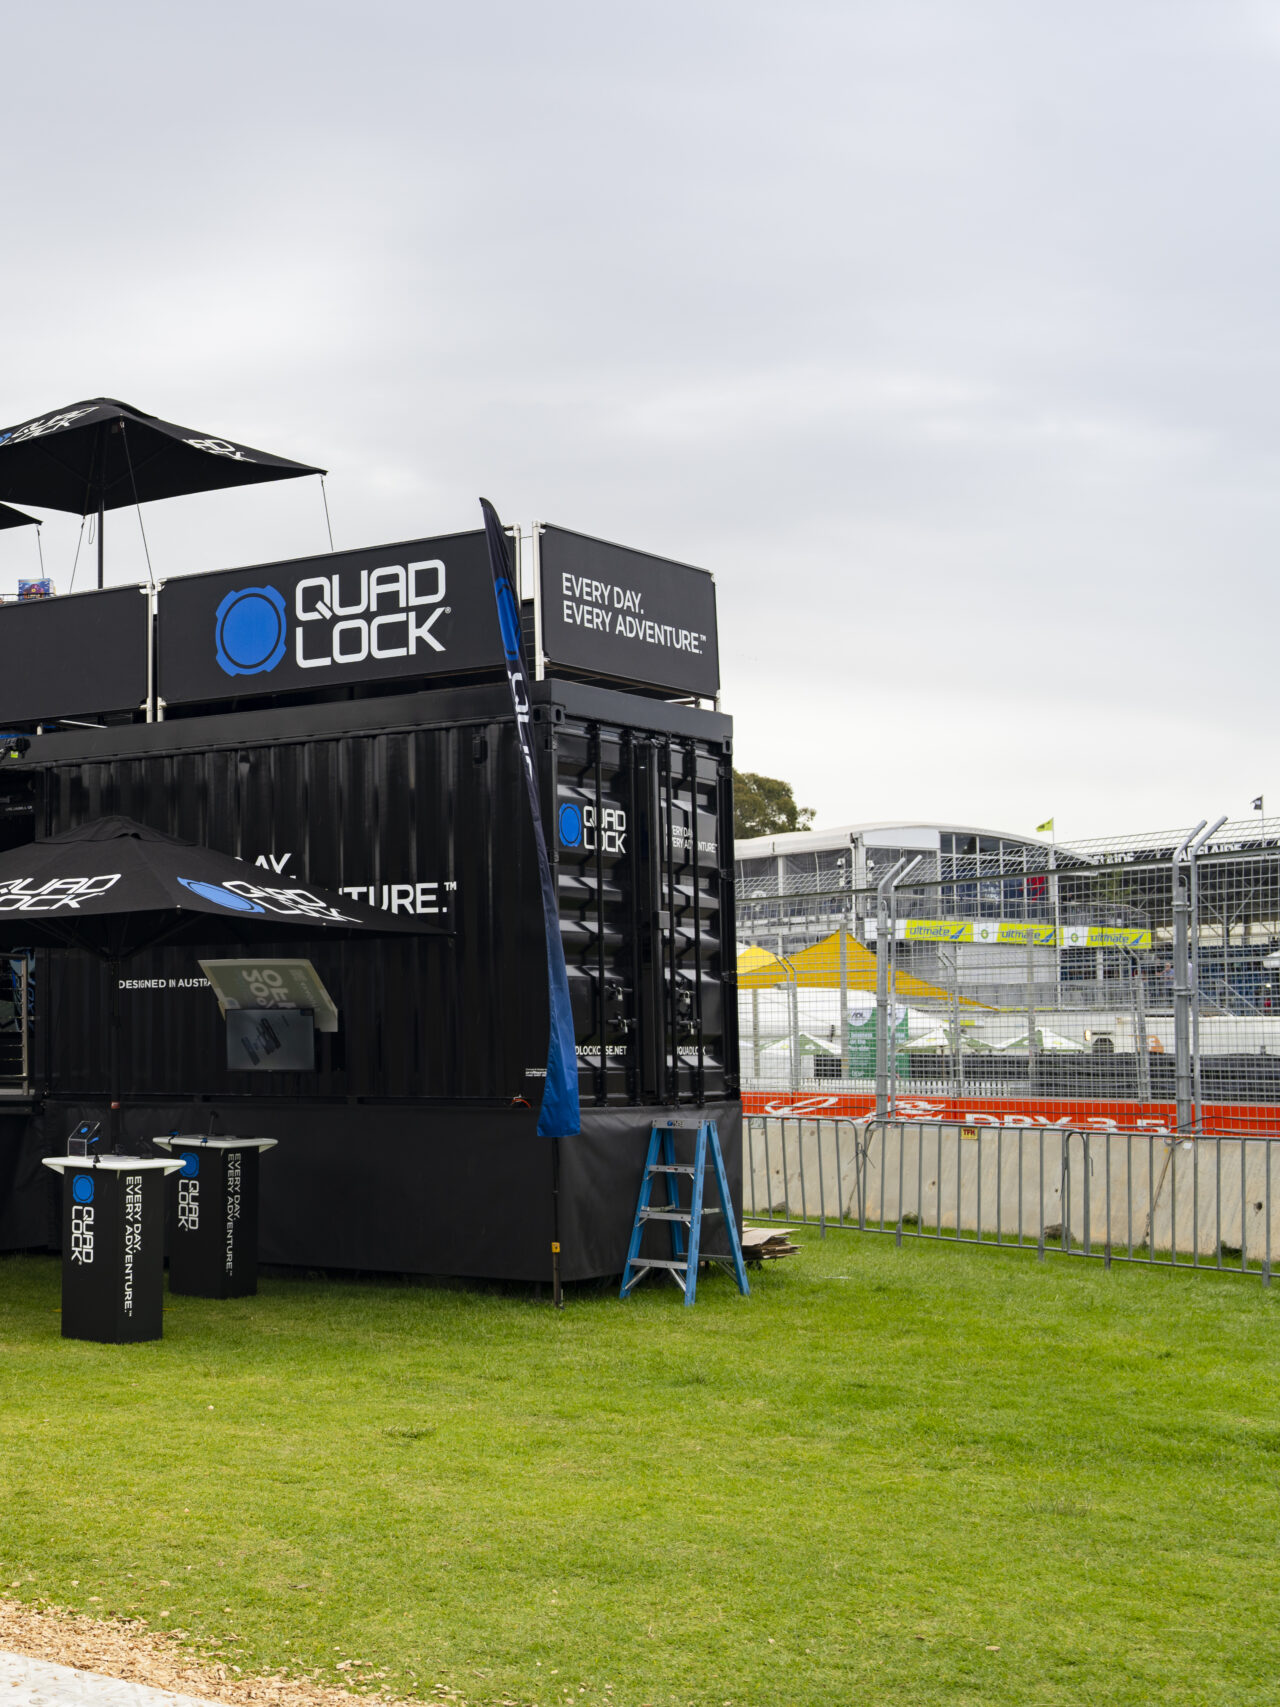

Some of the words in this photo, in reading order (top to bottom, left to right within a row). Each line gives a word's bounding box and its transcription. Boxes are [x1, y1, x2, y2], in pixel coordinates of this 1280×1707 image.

[295, 559, 446, 621] QUAD
[562, 572, 611, 606] EVERY
[613, 586, 644, 614] DAY.
[563, 600, 612, 632] EVERY
[583, 805, 627, 831] QUAD
[584, 827, 628, 854] LOCK
[222, 880, 327, 907] QUAD
[118, 979, 167, 989] DESIGNED
[169, 979, 176, 988] IN
[575, 1045, 627, 1056] DLOCKCSE.NET
[125, 1176, 133, 1222] EVERY
[134, 1176, 142, 1221] EVERY
[178, 1179, 189, 1230] LOCK
[188, 1180, 199, 1230] QUAD
[233, 1194, 241, 1220] DAY.
[71, 1205, 83, 1263] LOCK
[83, 1206, 94, 1263] QUAD
[133, 1223, 142, 1253] DAY.
